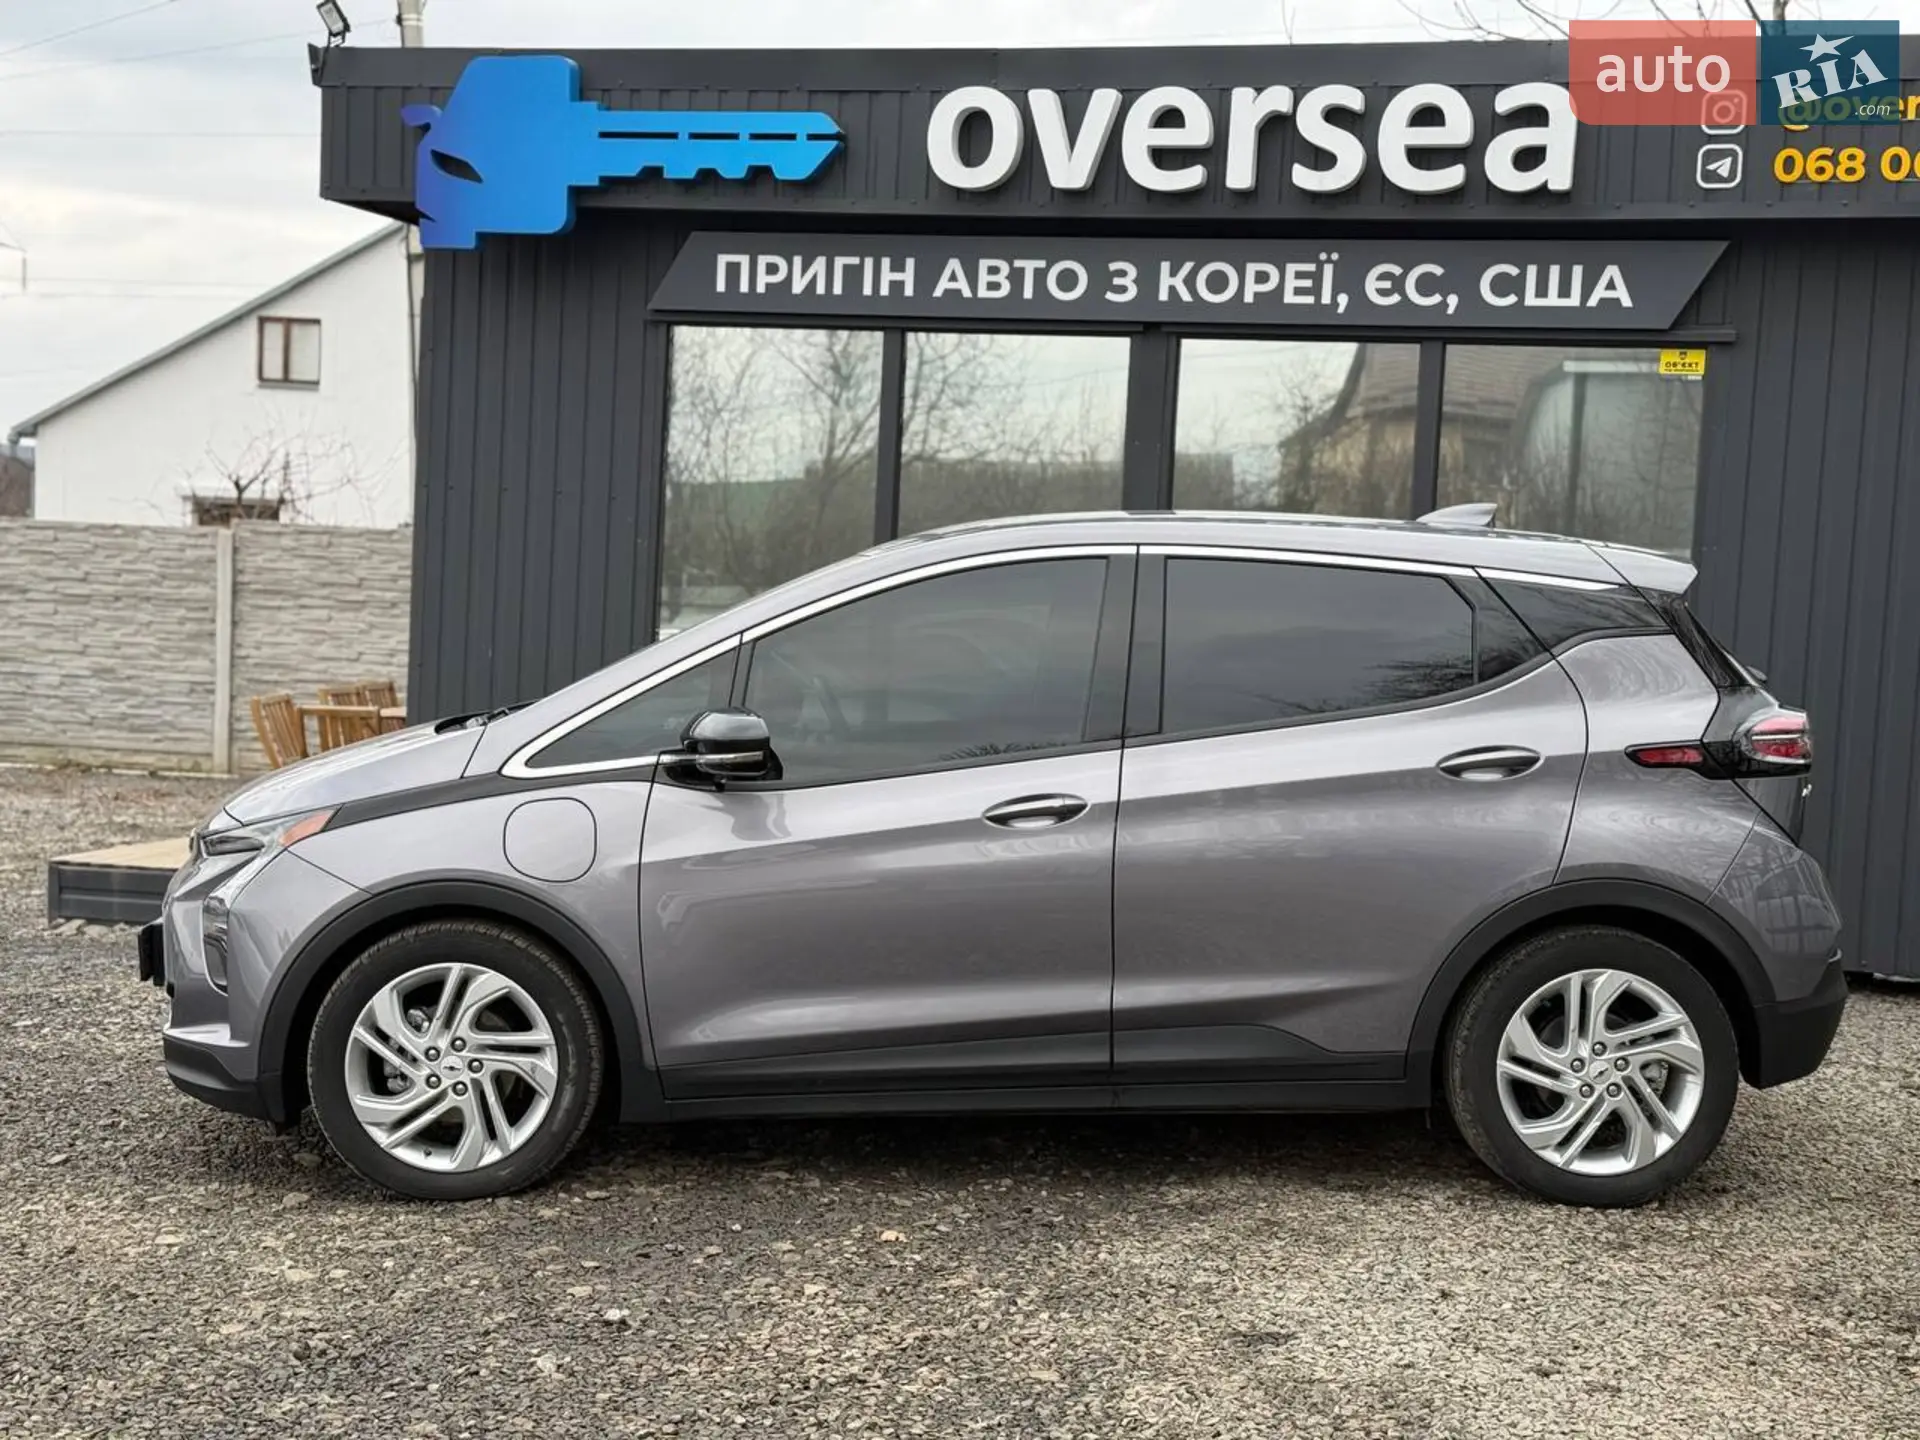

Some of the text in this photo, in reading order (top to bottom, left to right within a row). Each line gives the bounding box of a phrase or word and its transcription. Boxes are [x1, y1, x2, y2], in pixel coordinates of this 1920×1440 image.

[927, 82, 1578, 194] oversea
[1773, 146, 1920, 183] 068 0
[715, 253, 916, 297] ПРИГІН
[932, 258, 1089, 301] АВТО
[1158, 252, 1349, 314] КОРЕЇ,
[1364, 263, 1459, 315] ЄС,
[1479, 264, 1634, 308] США
